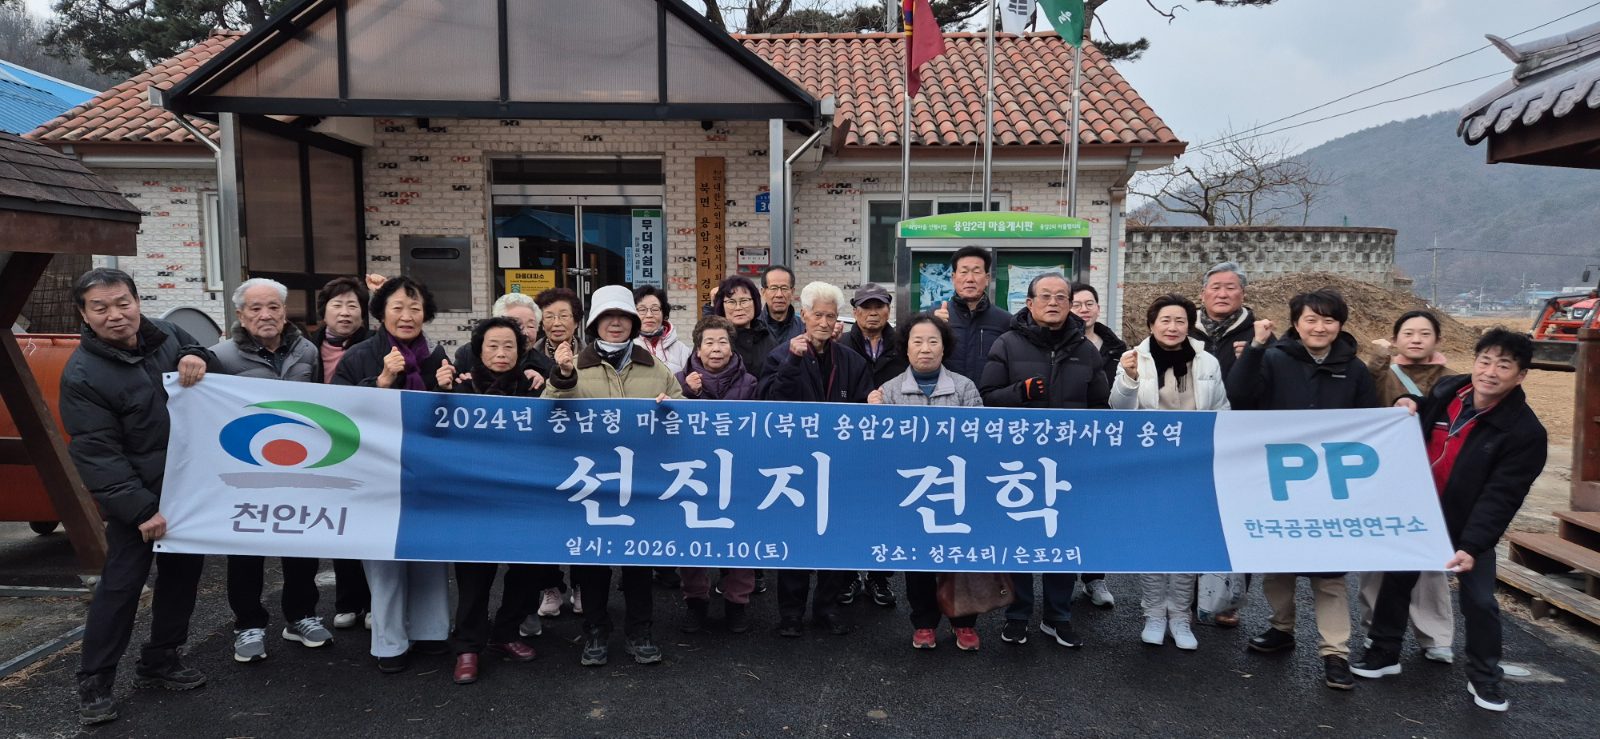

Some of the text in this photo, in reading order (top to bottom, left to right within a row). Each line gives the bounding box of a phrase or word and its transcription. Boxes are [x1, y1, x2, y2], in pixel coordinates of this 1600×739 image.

[700, 182, 710, 208] 북면
[700, 216, 711, 270] 용암2리
[953, 220, 1034, 232] 용암2리 마을게시판
[641, 219, 653, 278] 무더위쉼터
[434, 406, 533, 432] 2024년
[547, 408, 621, 434] 충남형
[637, 409, 820, 439] 마을만들기(북면
[1137, 421, 1182, 447] 용역
[1264, 441, 1380, 502] PP
[556, 446, 1072, 537] 선진지 견학
[229, 502, 348, 536] 천안시
[1243, 515, 1429, 539] 한국공공번영연구소
[565, 537, 790, 562] 일시: 2026.01.10(토)
[871, 544, 1083, 565] 장소: 성주4리/은포2리
